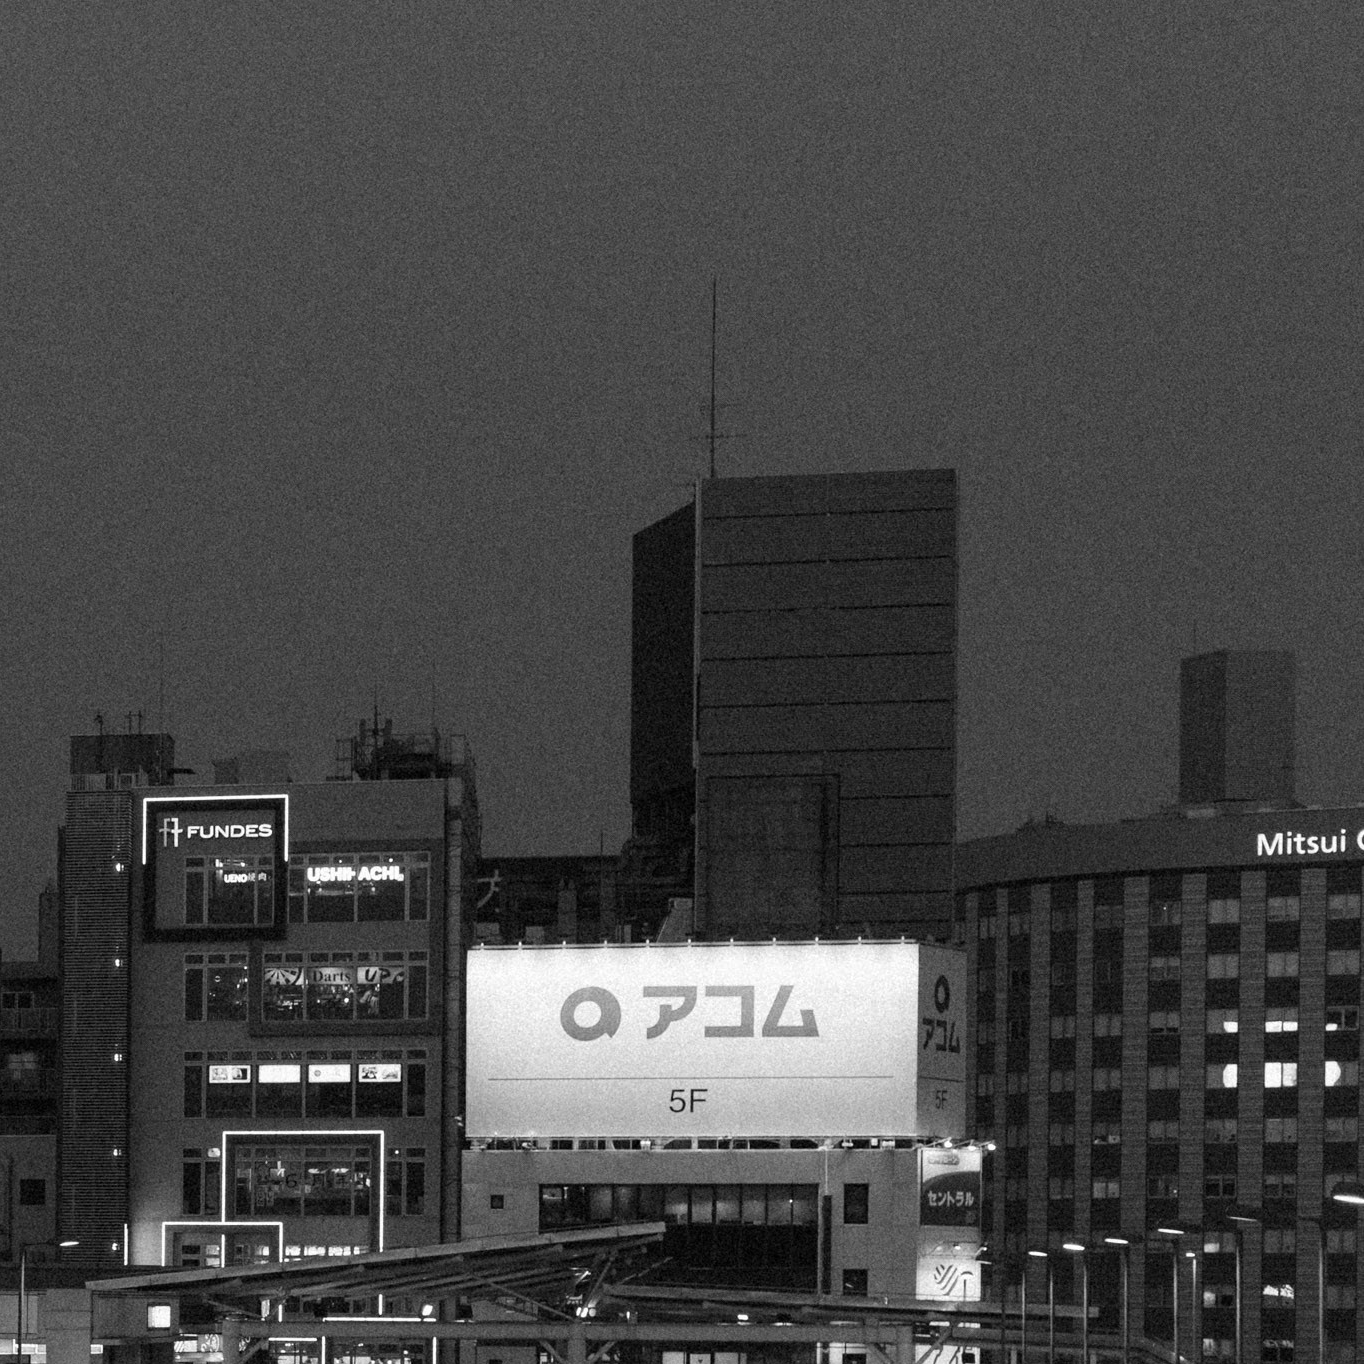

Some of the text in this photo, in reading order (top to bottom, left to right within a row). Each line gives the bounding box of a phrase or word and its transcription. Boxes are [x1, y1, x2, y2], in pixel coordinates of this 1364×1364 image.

[187, 823, 273, 839] FUNDES
[1257, 828, 1347, 856] Mitsui
[313, 970, 351, 982] Darts
[642, 985, 820, 1040] アコム
[922, 1018, 961, 1053] アコム
[669, 1088, 708, 1113] 5F
[935, 1090, 948, 1110] 5F
[927, 1190, 975, 1207] セントラル
